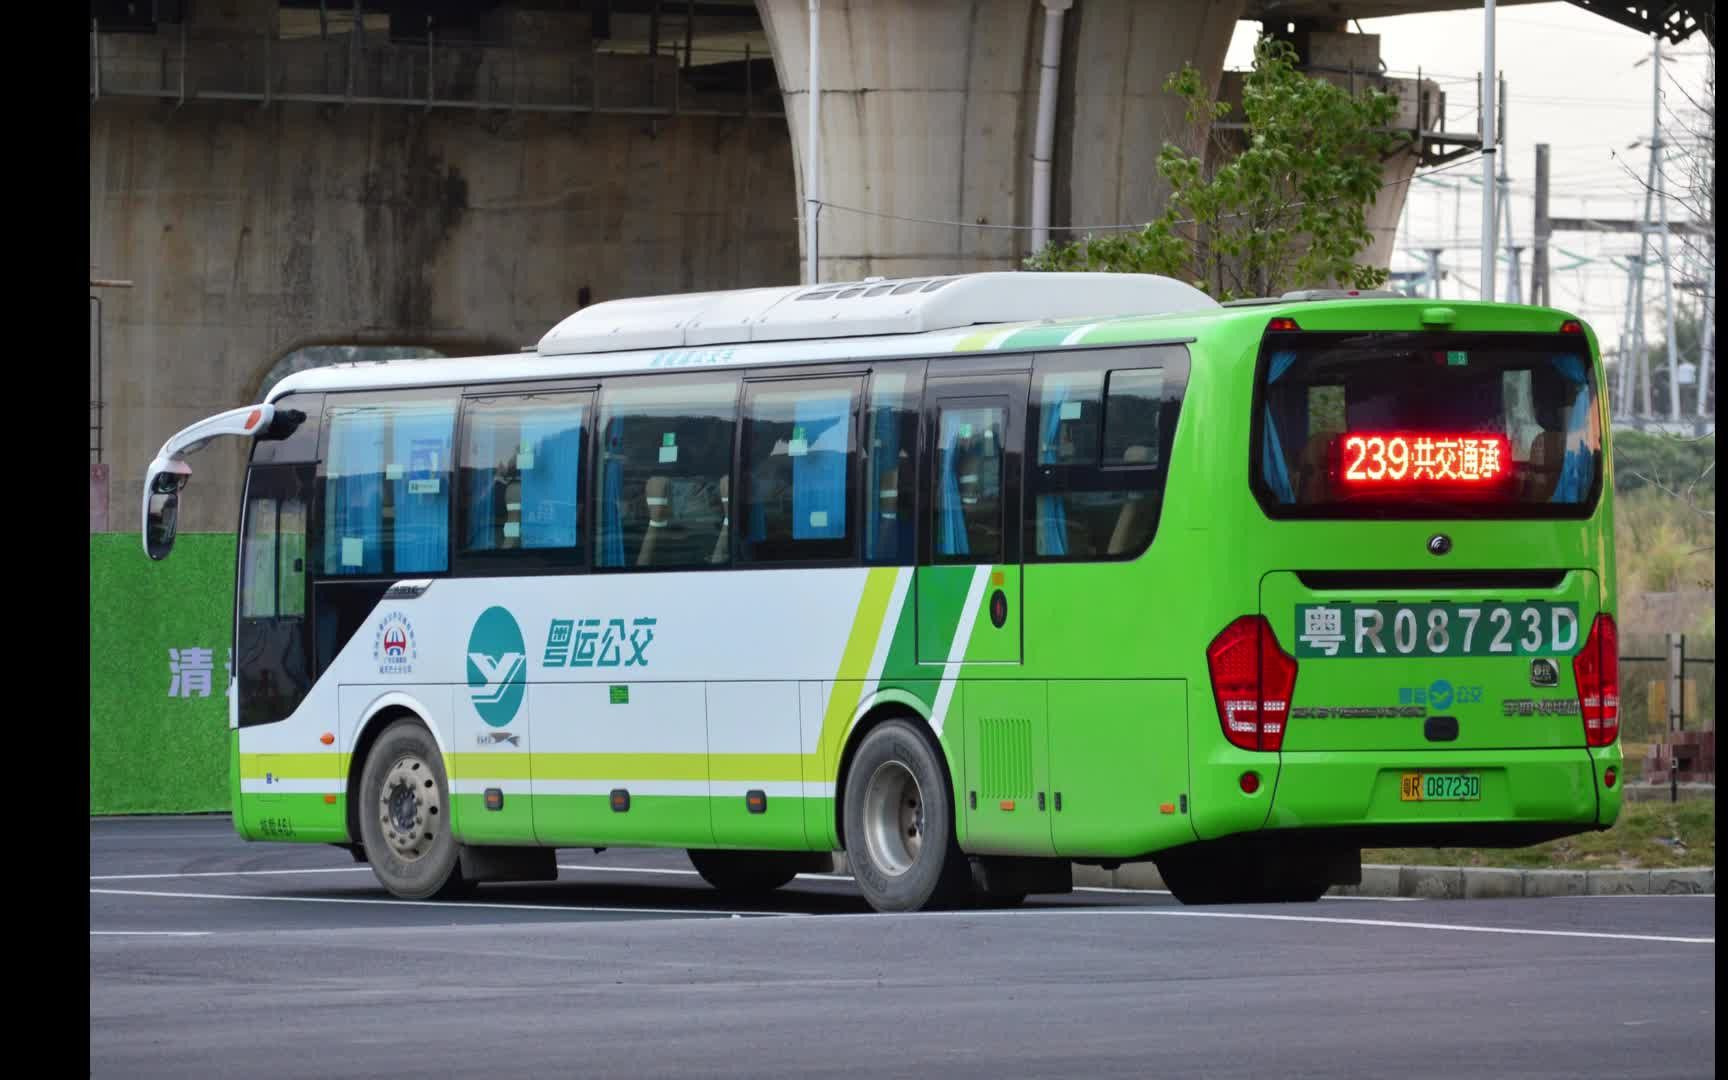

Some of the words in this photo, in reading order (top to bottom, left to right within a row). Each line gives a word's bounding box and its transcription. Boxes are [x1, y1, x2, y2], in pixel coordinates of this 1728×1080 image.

[1346, 436, 1409, 480] 239
[542, 616, 658, 667] 粤运公交
[1300, 606, 1578, 656] 粤R08723D
[168, 646, 233, 698] 清
[1427, 775, 1479, 797] 08723D
